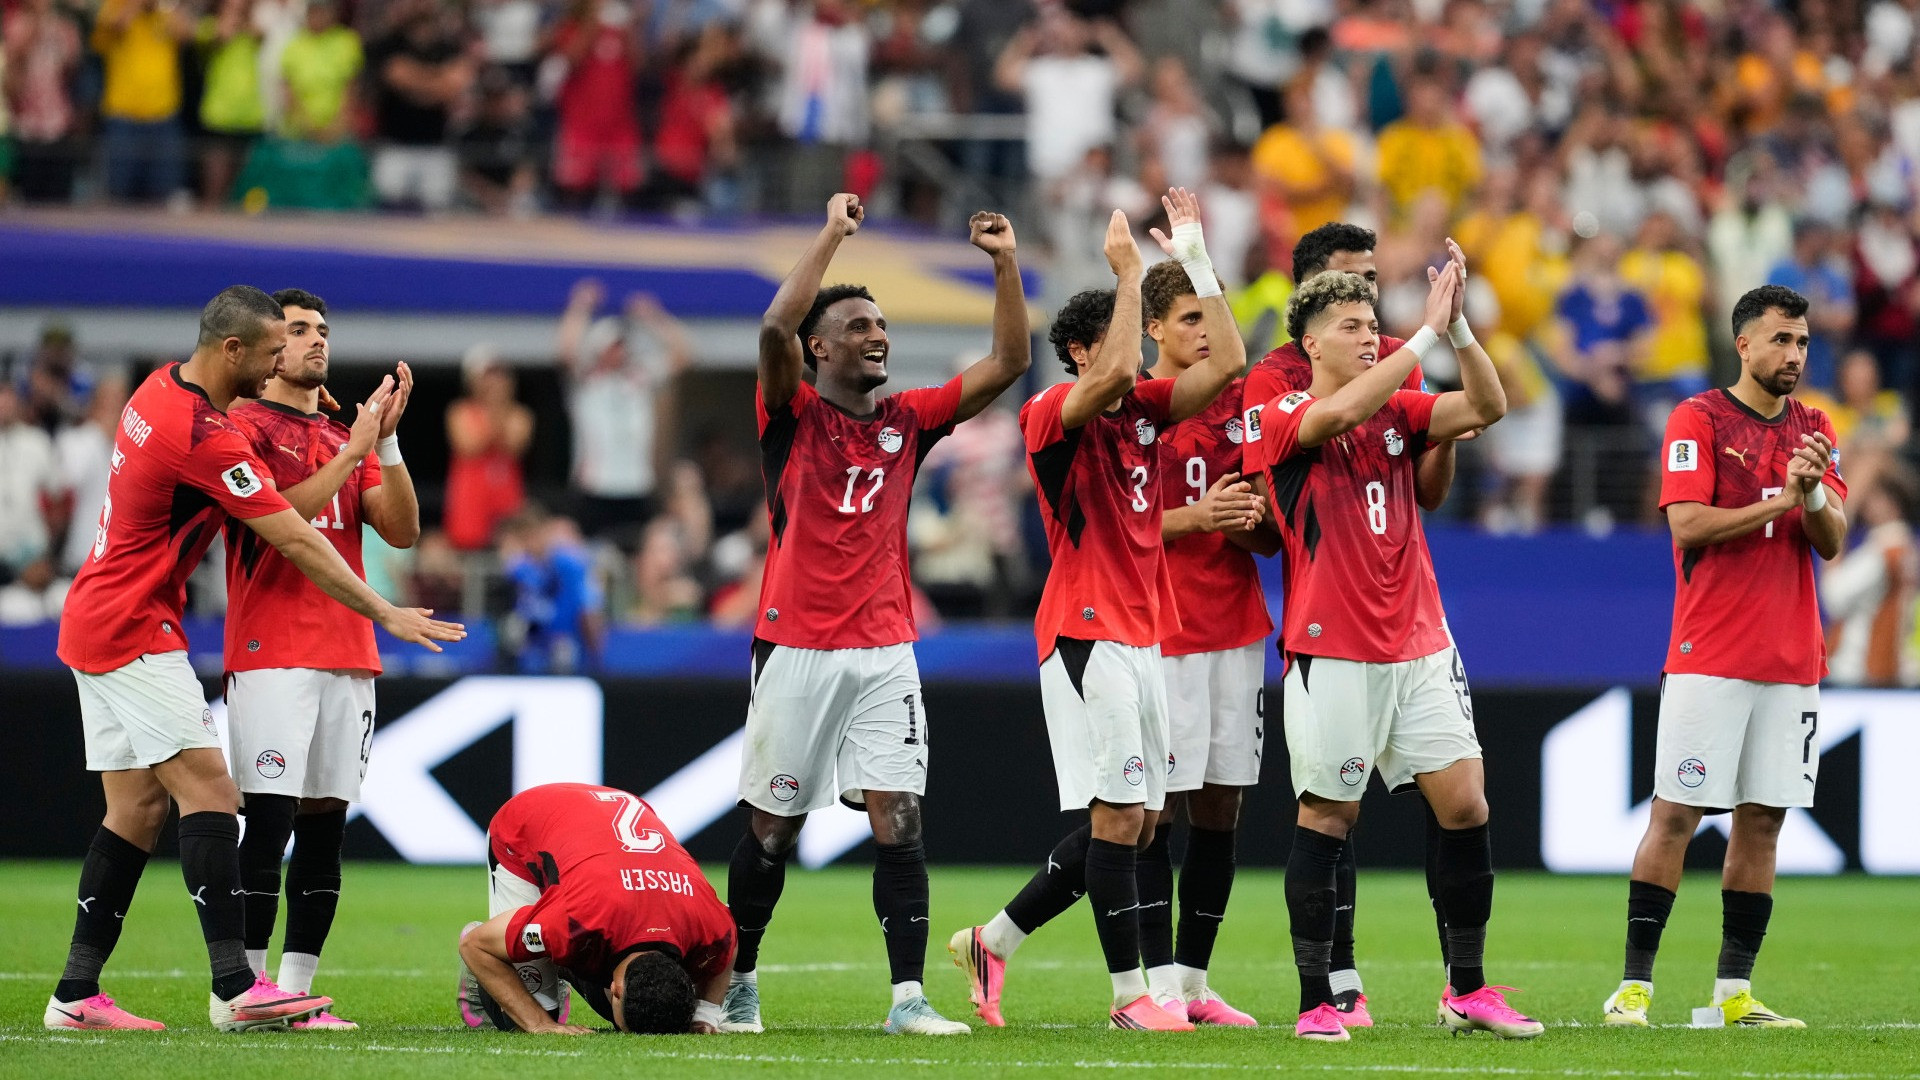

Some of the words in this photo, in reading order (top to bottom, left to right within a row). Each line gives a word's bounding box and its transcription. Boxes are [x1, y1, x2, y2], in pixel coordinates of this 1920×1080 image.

[838, 465, 885, 513] 12
[1131, 466, 1148, 512] 3
[1186, 457, 1207, 506] 9
[1366, 481, 1387, 534] 8
[903, 694, 928, 746] 1
[1801, 711, 1817, 763] 7
[589, 790, 666, 853] 2
[620, 868, 694, 896] YASSER
